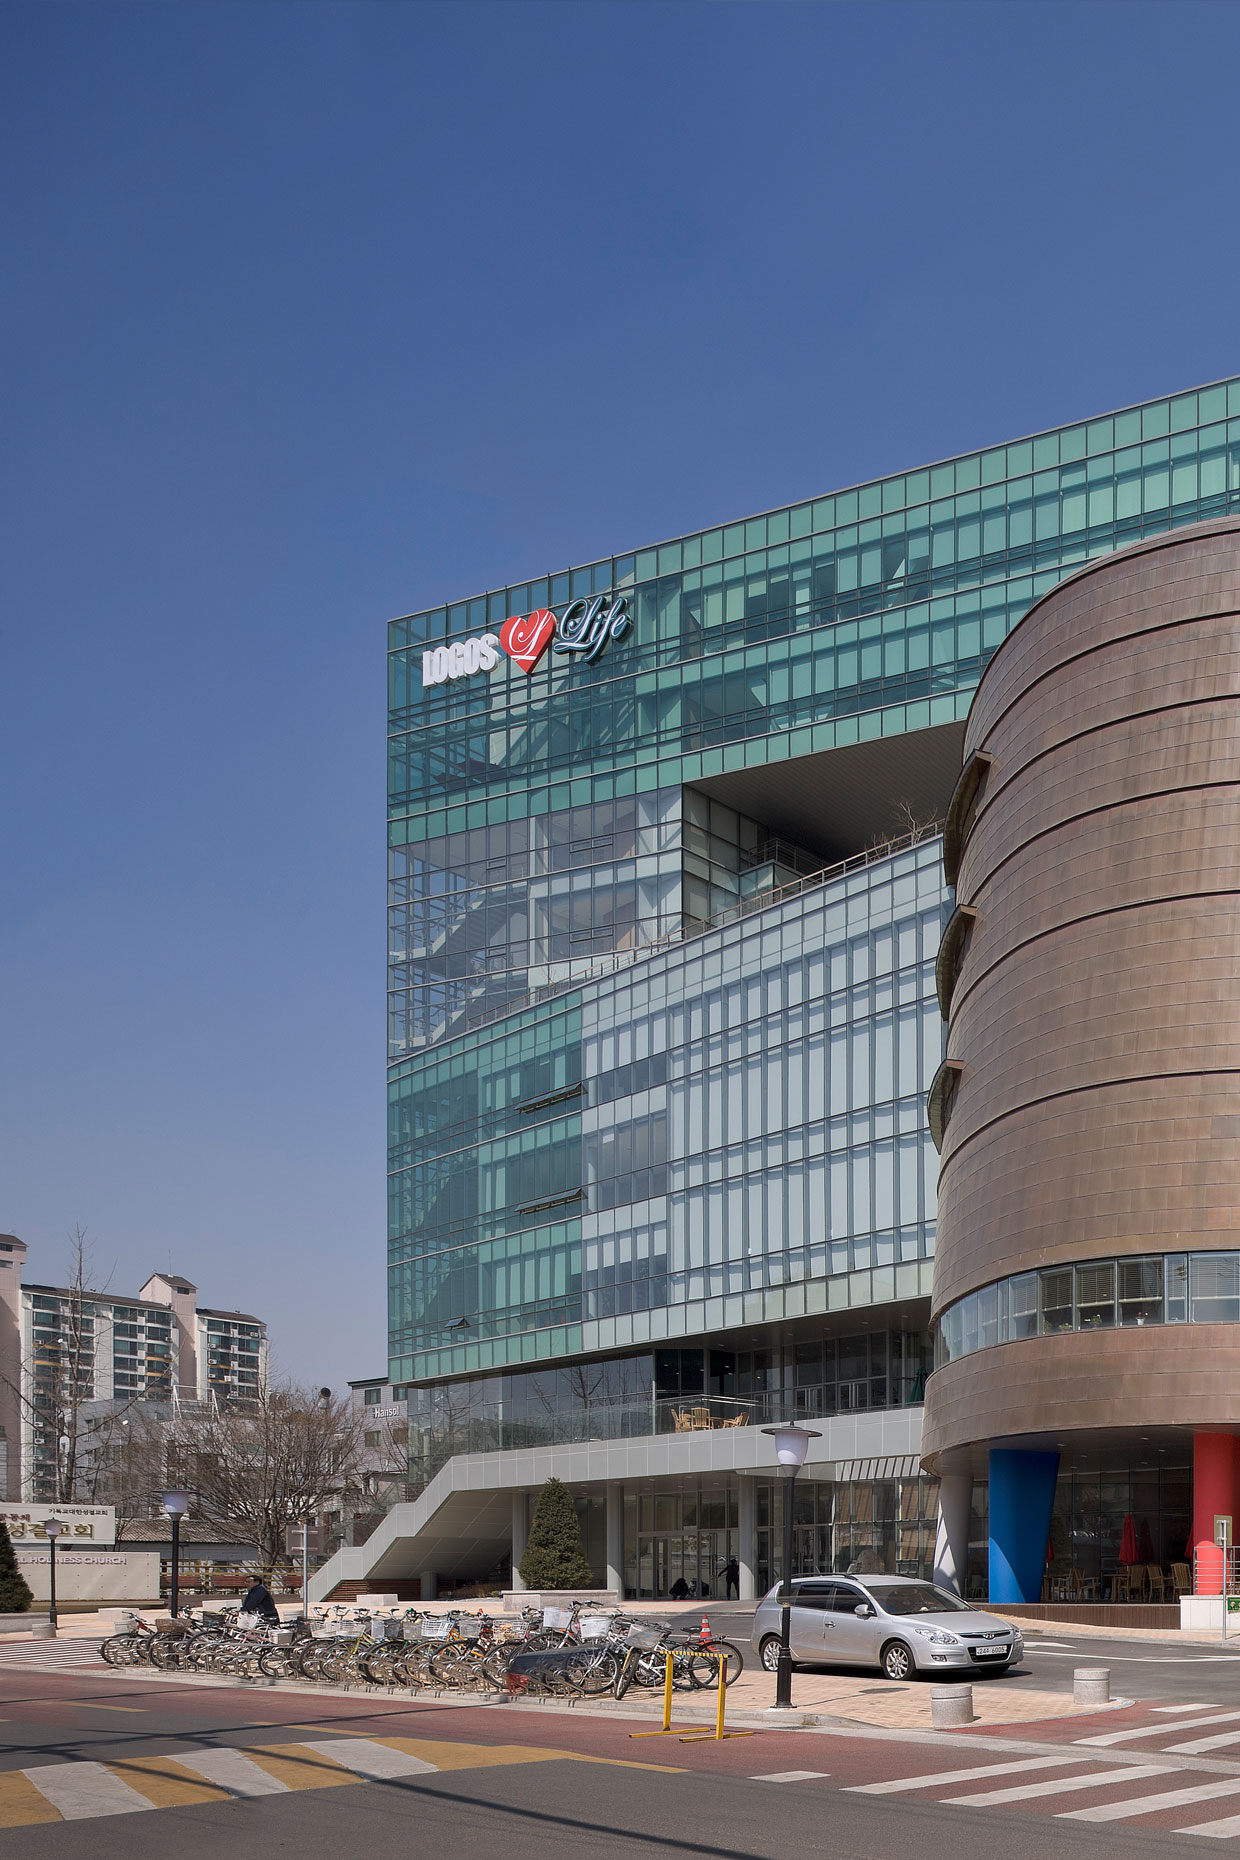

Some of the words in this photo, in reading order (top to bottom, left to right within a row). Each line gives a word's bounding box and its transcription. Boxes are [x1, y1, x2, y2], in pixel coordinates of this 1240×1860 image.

[422, 632, 499, 687] LOGOS
[553, 596, 632, 664] Life
[374, 1405, 400, 1418] Hansol
[30, 1556, 82, 1564] HOLNESS
[84, 1557, 127, 1565] CHURCH
